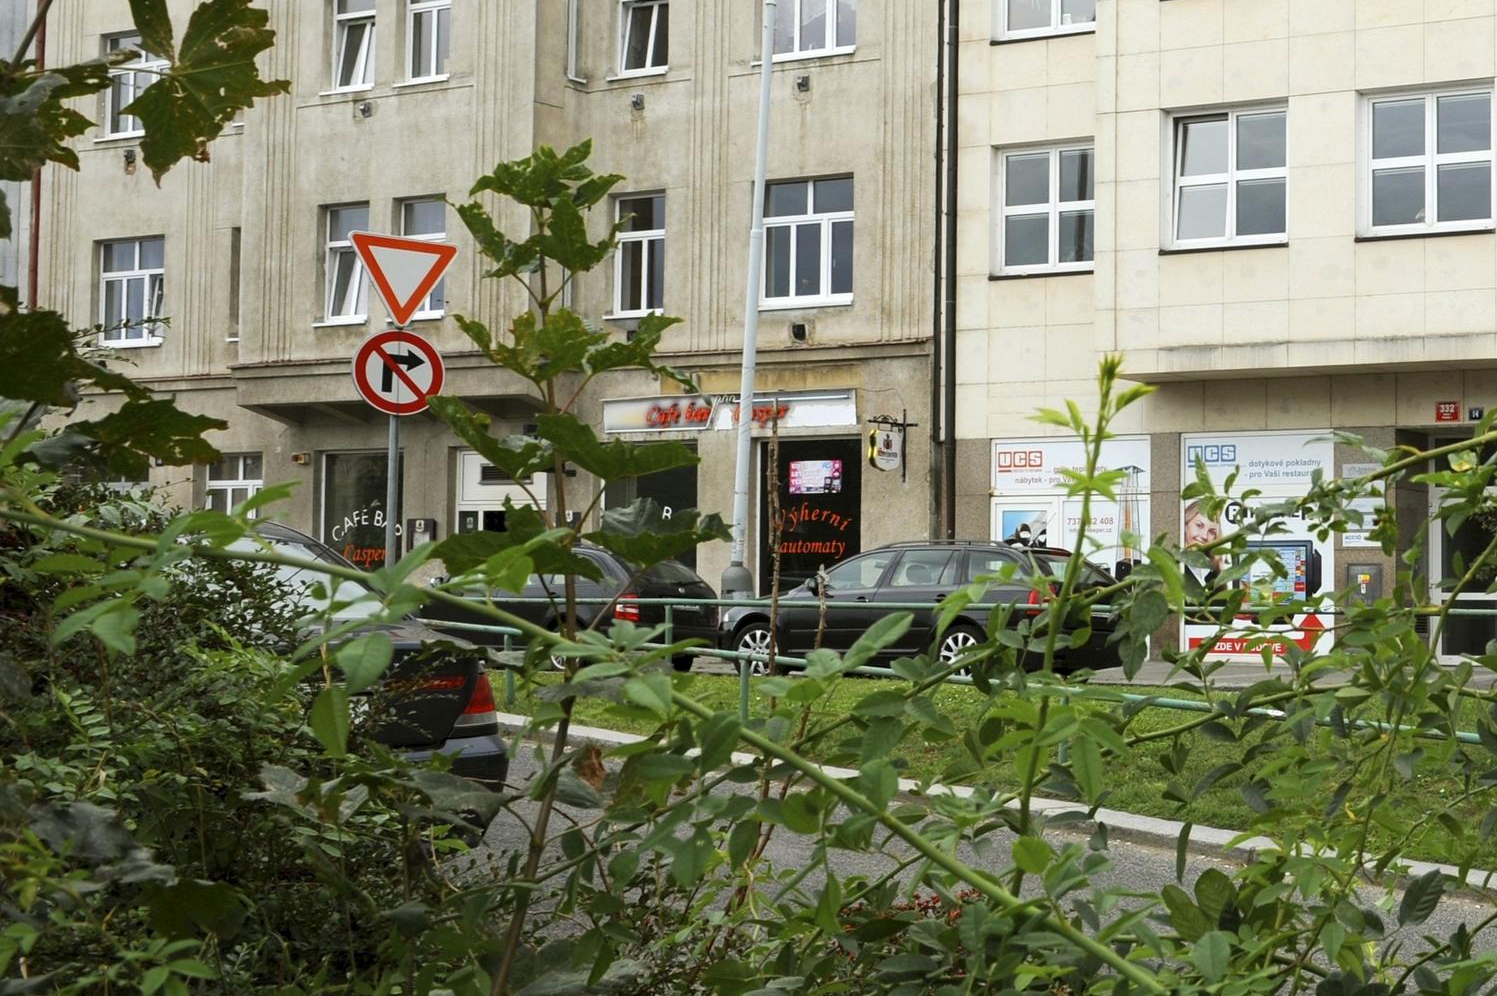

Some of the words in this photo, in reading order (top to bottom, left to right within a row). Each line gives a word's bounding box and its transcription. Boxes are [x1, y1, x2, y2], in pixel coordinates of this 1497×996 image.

[1440, 404, 1455, 413] 332
[1248, 458, 1284, 468] dotykové
[1285, 457, 1321, 468] pokladny
[1249, 471, 1262, 479] pro
[1263, 469, 1281, 478] Vaši
[1015, 476, 1042, 484] nábytek
[332, 508, 369, 541] CAFÉ
[779, 540, 845, 558] automaty
[1214, 642, 1232, 651] ZDE
[1234, 642, 1241, 651] V
